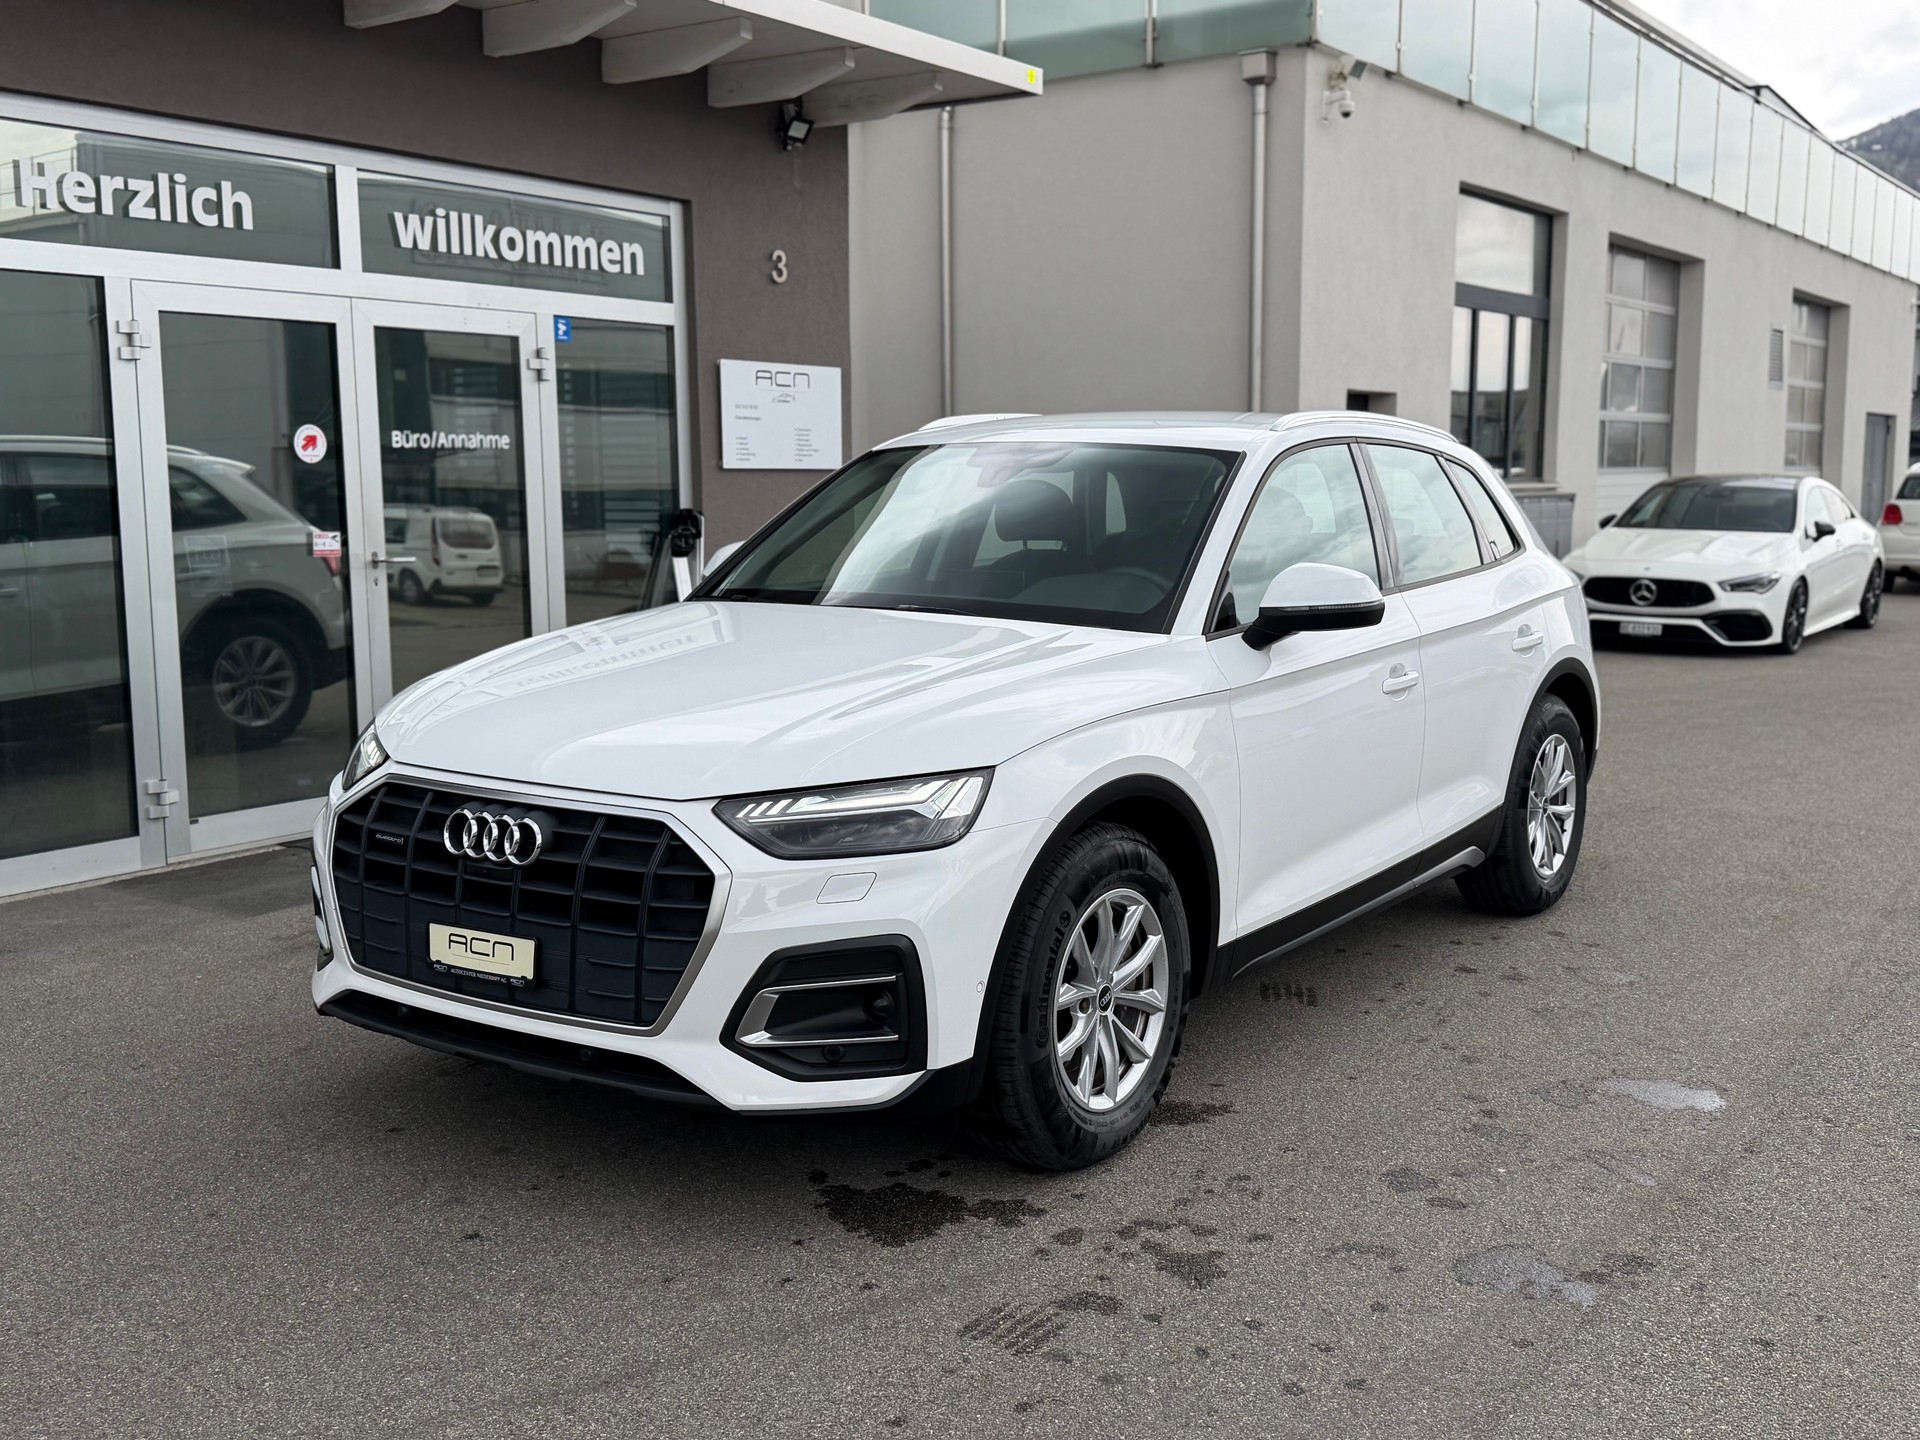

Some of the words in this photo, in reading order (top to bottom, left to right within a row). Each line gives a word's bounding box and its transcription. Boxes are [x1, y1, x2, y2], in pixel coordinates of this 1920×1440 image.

[18, 158, 254, 230] Herzlich
[393, 207, 645, 276] willkommen
[772, 249, 788, 283] 3
[755, 370, 810, 389] ACN
[391, 430, 511, 450] Büro/Annahme
[448, 933, 514, 961] ACN
